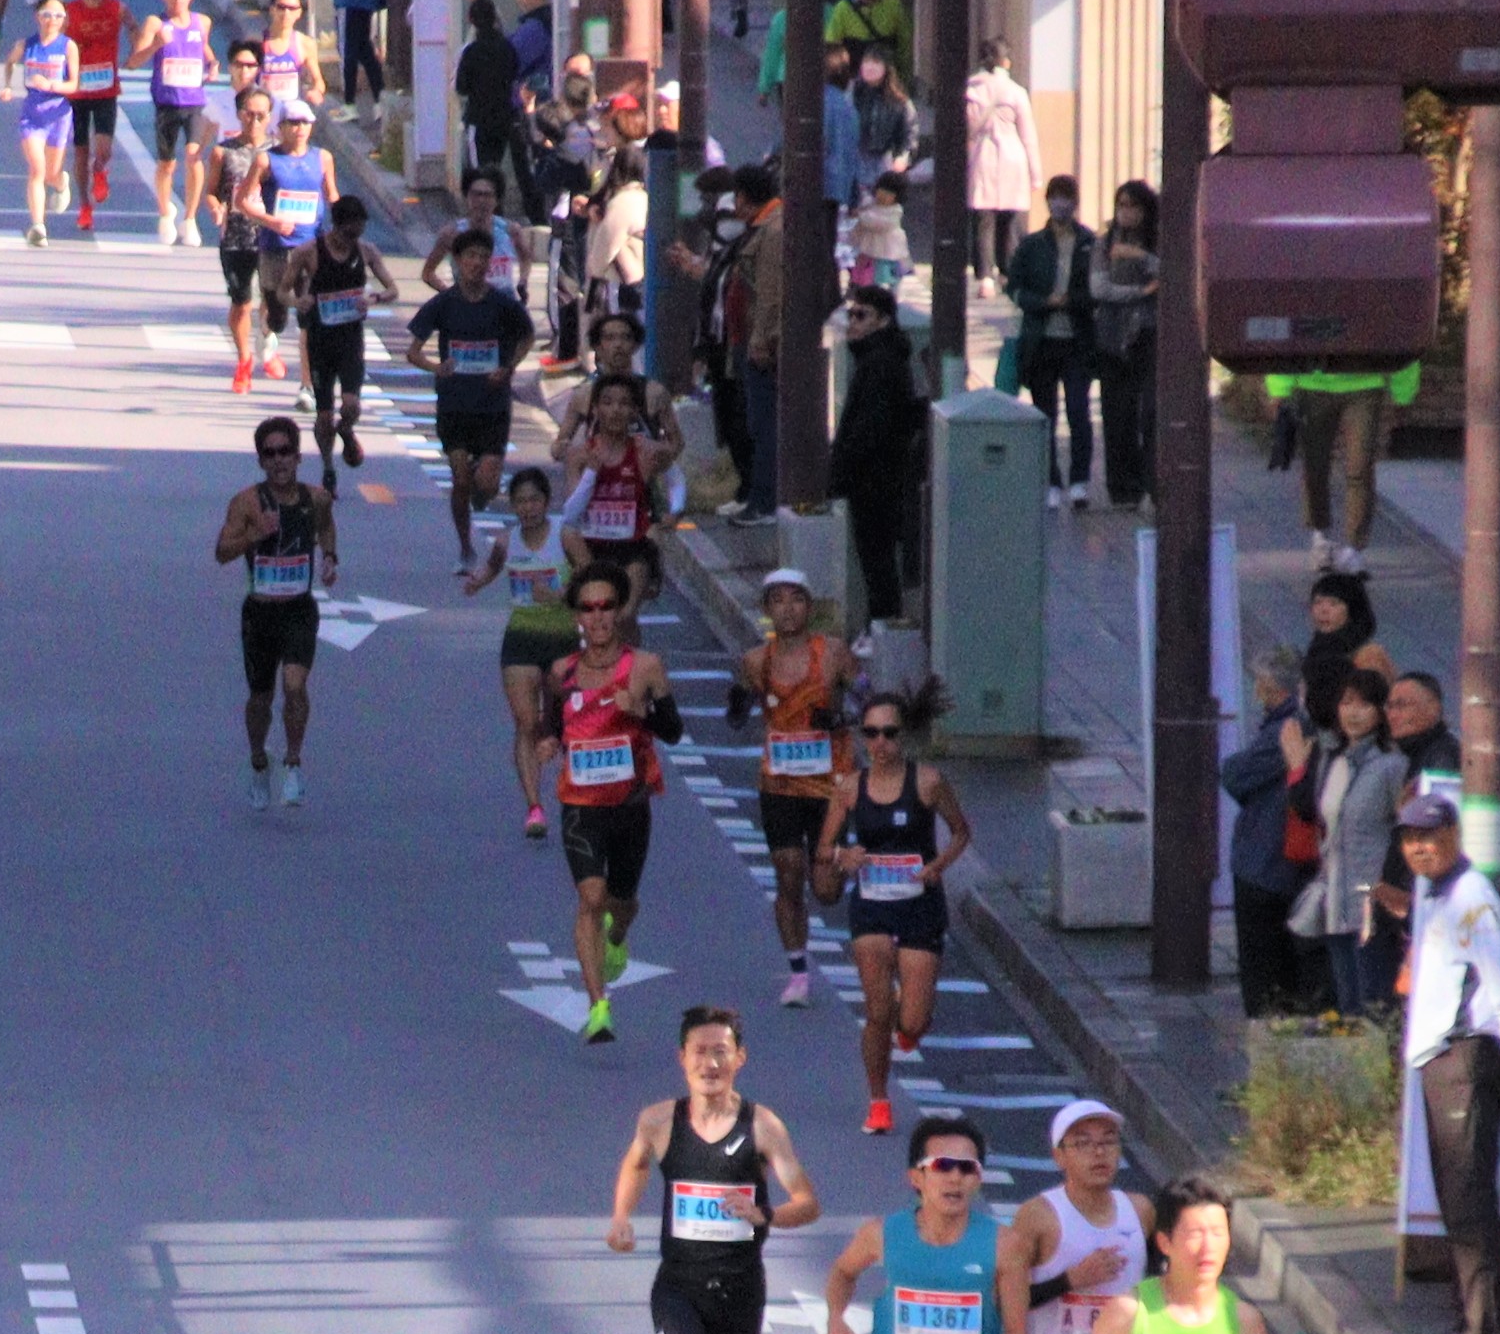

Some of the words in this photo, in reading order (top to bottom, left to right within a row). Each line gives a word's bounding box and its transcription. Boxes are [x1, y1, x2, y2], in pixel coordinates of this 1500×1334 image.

[678, 1198, 687, 1217] B
[901, 1304, 910, 1325] B
[920, 1304, 971, 1331] 1367
